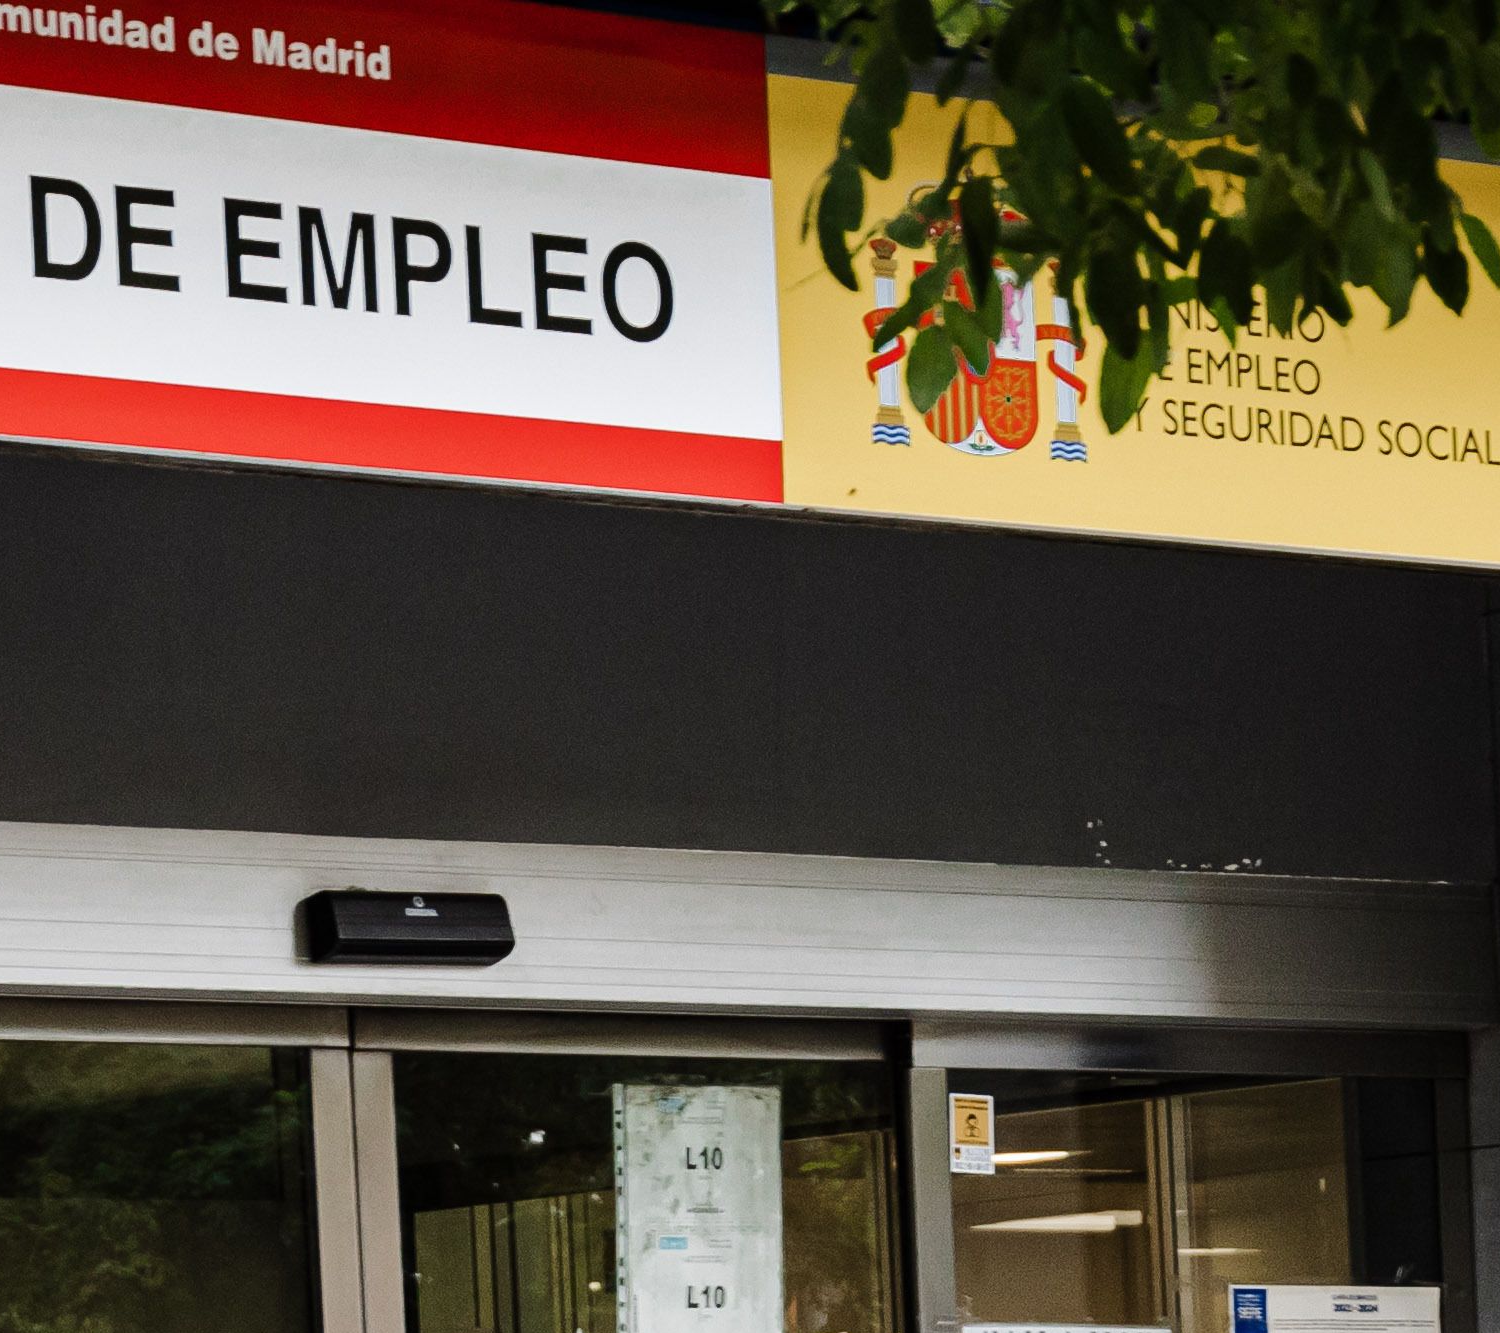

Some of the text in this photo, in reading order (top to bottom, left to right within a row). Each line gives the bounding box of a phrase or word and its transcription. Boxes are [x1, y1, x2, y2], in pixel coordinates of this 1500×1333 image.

[189, 23, 239, 60] de
[252, 27, 392, 81] Madrid
[30, 175, 181, 292] DE
[222, 196, 675, 343] EMPLEO
[1186, 348, 1321, 396] EMPLEO
[1163, 399, 1365, 452] SEGURIDAD
[686, 1147, 723, 1170] L10
[686, 1285, 726, 1309] L10
